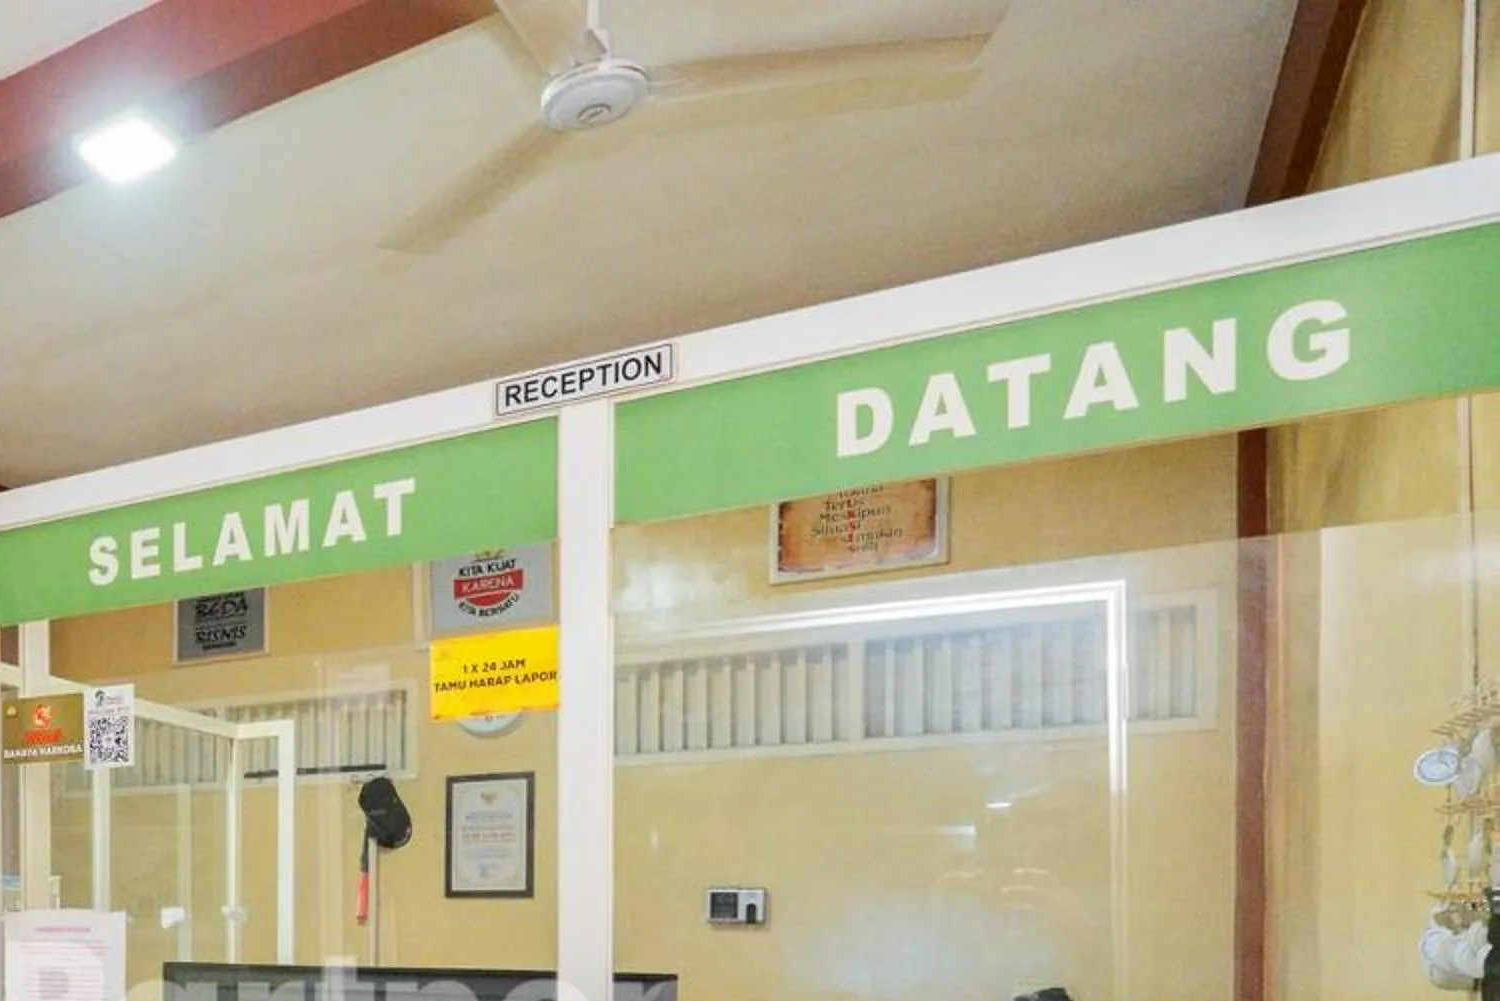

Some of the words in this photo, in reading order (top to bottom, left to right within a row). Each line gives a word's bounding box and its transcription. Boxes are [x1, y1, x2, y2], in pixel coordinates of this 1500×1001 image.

[505, 352, 662, 407] RECEPTION
[837, 300, 1350, 457] DATANG
[88, 477, 416, 586] SELAMAT
[459, 565, 484, 577] KITA
[487, 559, 517, 573] KUAT
[461, 575, 515, 593] KARENA
[471, 663, 479, 673] X
[500, 658, 526, 670] JAM
[435, 680, 466, 692] TAMU
[469, 675, 511, 689] HARAP
[515, 671, 557, 685] LAPOR
